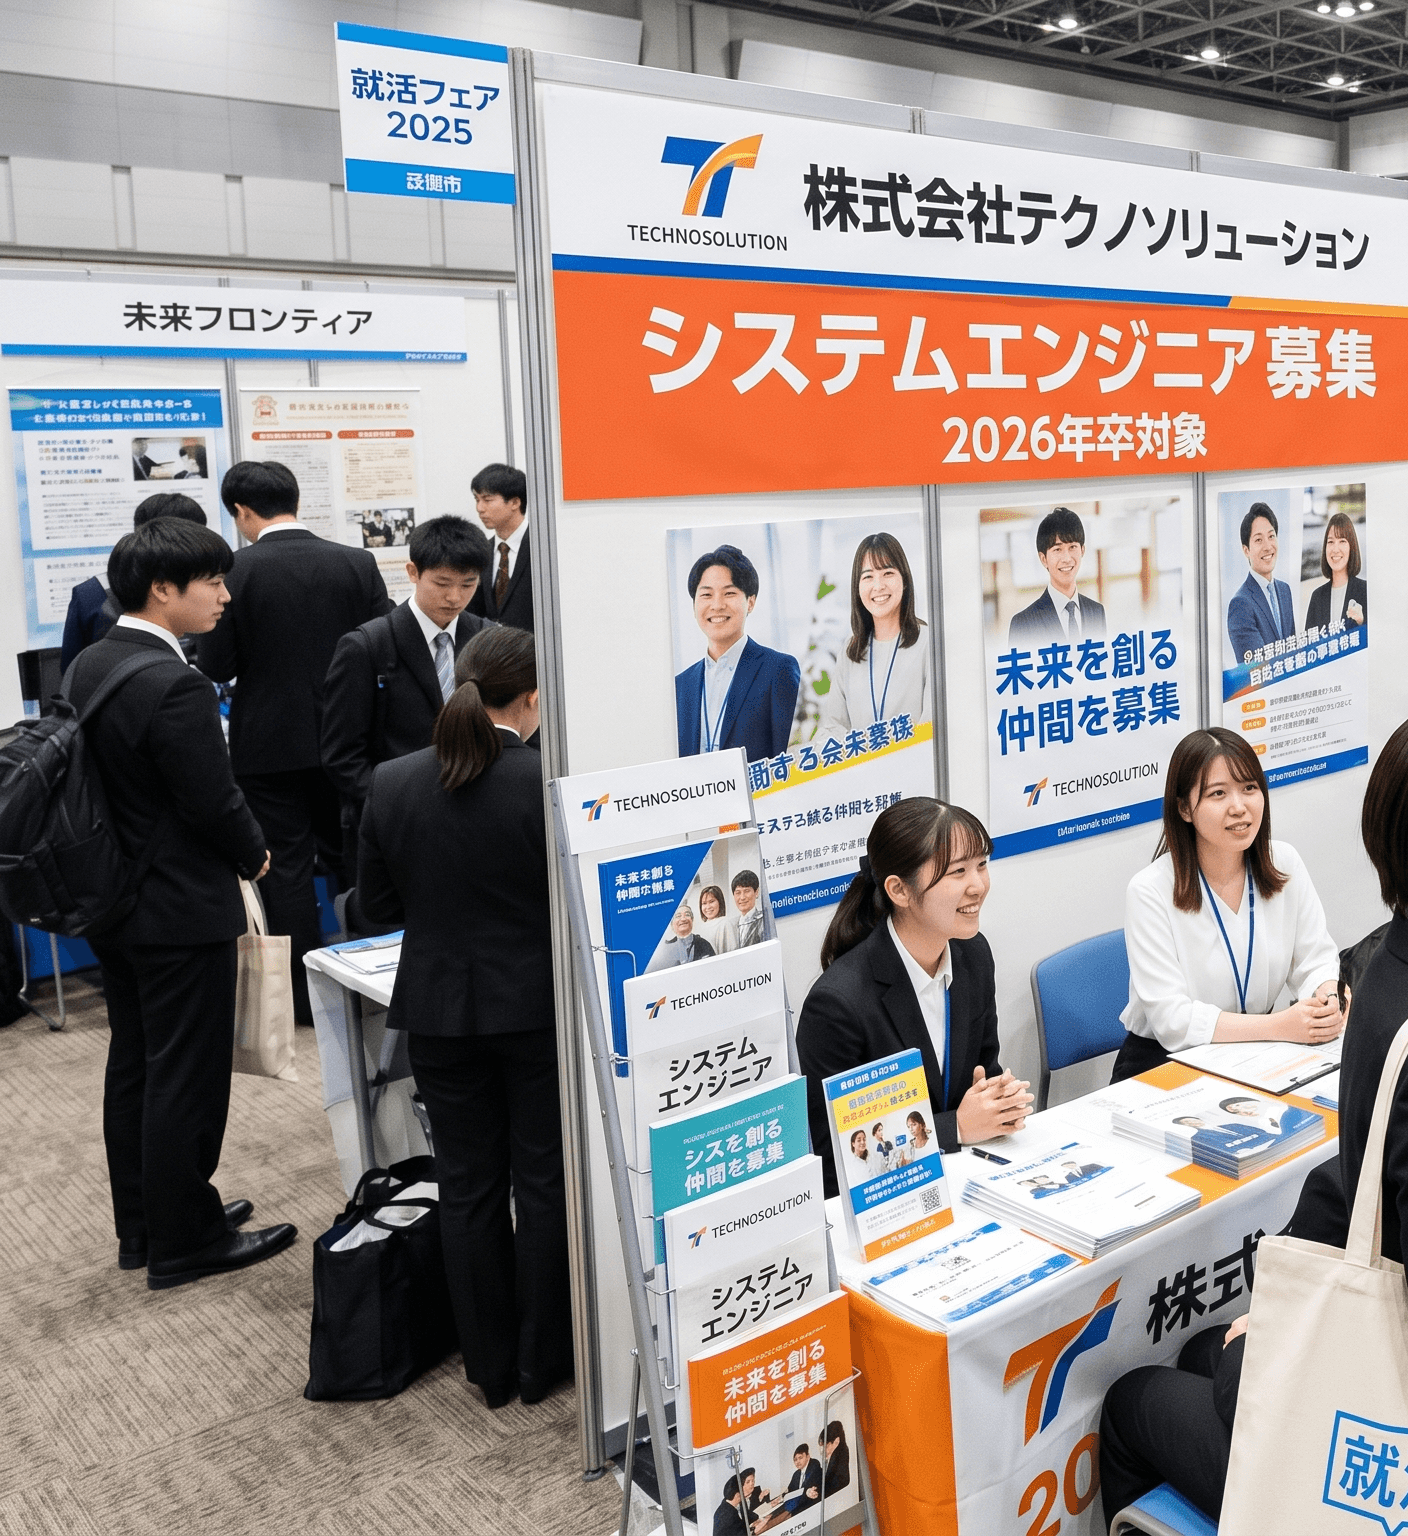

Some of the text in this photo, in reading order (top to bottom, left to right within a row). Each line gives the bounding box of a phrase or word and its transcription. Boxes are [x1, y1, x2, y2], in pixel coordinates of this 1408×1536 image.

[351, 67, 500, 111] 就活フェア
[387, 111, 473, 145] 2025
[627, 224, 788, 251] TECHNOSOLUTION
[802, 163, 1370, 272] 株式会社テクノソリューション
[123, 301, 373, 335] 未来フロンティア
[641, 306, 1378, 399] システムエンジニア募集
[942, 412, 1208, 464] 2026年卒対象
[995, 629, 1178, 696] 未来を創る
[996, 681, 1180, 756] 仲間を募集
[613, 778, 736, 812] TECHNOSOLUTION
[1052, 762, 1159, 797] TECHNOSOLUTION
[670, 973, 772, 1011] TECHNOSOLUTION
[658, 1056, 772, 1113] エンジニア
[669, 1036, 758, 1082] システム
[685, 1118, 782, 1171] シスを創る
[685, 1141, 784, 1197] 仲間を募集
[702, 1273, 813, 1344] エンジニア
[712, 1257, 800, 1311] システム
[724, 1339, 825, 1402] 未来を創る
[724, 1362, 827, 1428] 仲間を募集
